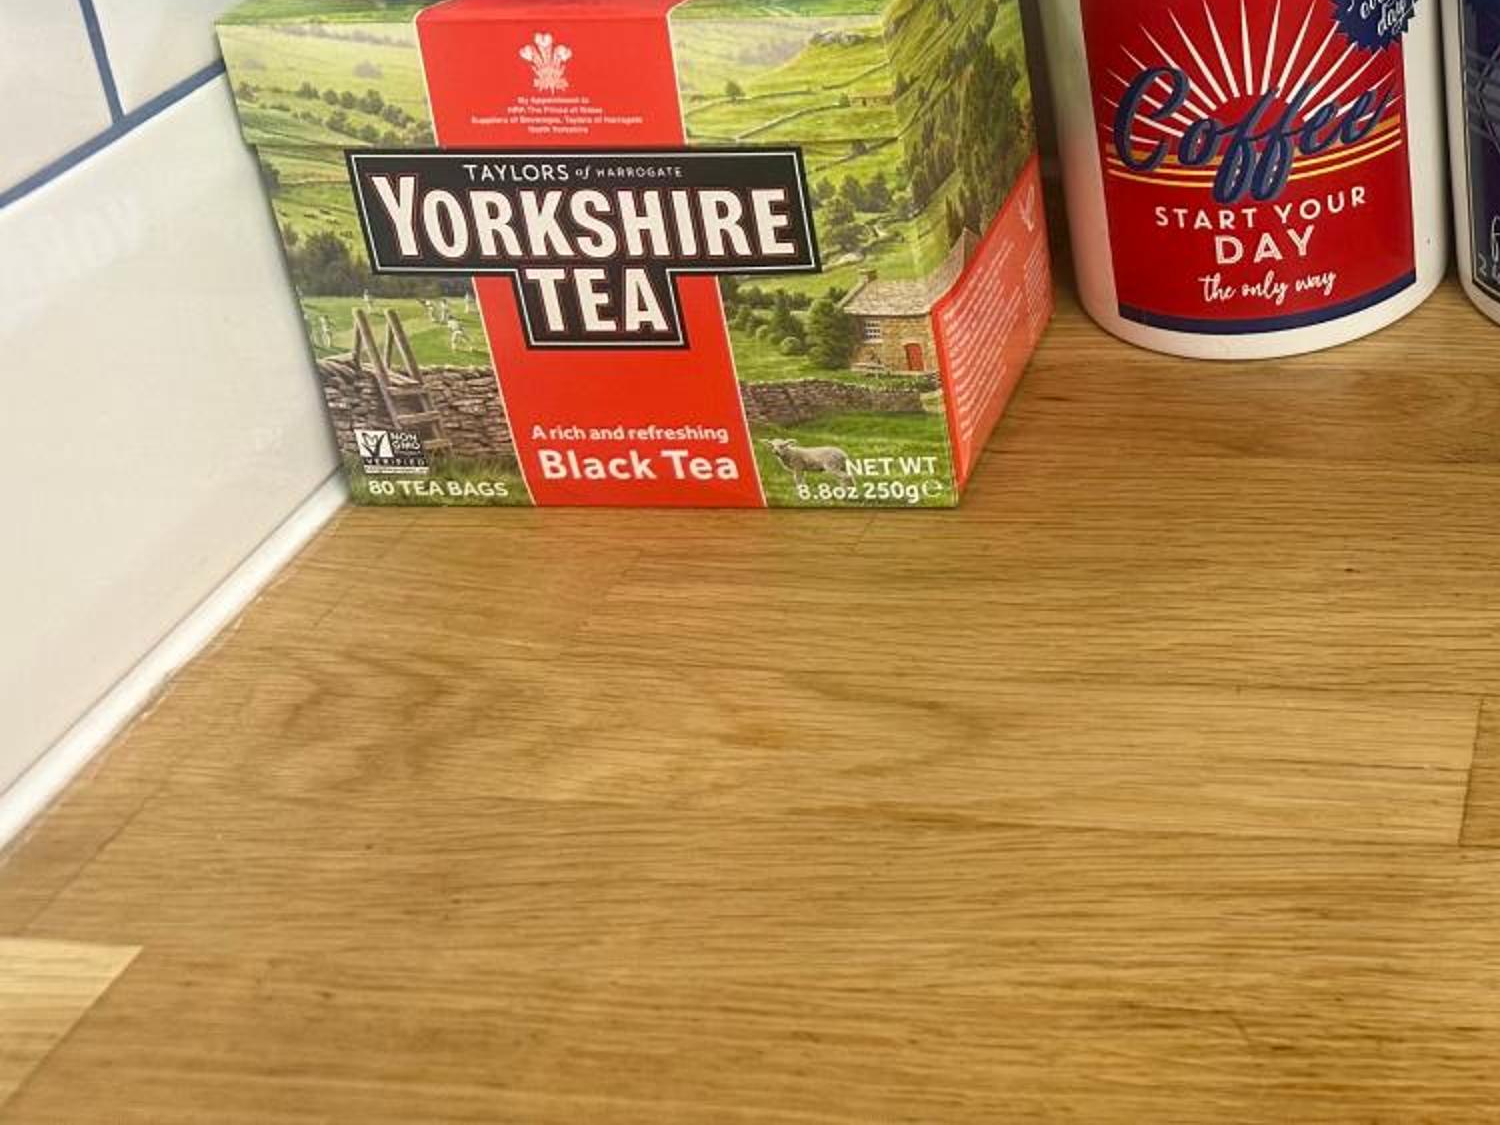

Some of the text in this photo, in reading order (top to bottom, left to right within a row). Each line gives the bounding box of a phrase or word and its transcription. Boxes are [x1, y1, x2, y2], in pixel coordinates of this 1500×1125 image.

[1114, 65, 1394, 205] Coffee
[464, 164, 683, 183] TAYLORS of HARROGATE
[372, 175, 796, 259] YORKSHIRE
[1155, 186, 1366, 230] START YOUR
[1214, 225, 1315, 264] DAY
[525, 268, 669, 333] TEA
[1198, 270, 1337, 305] the only way
[390, 433, 417, 442] NON
[531, 425, 730, 443] A rich and refreshing
[537, 448, 739, 480] Black Tea
[846, 456, 938, 476] NET WT
[368, 480, 509, 496] 80 TEA BAGS
[798, 482, 921, 503] 8.8oz 250g
